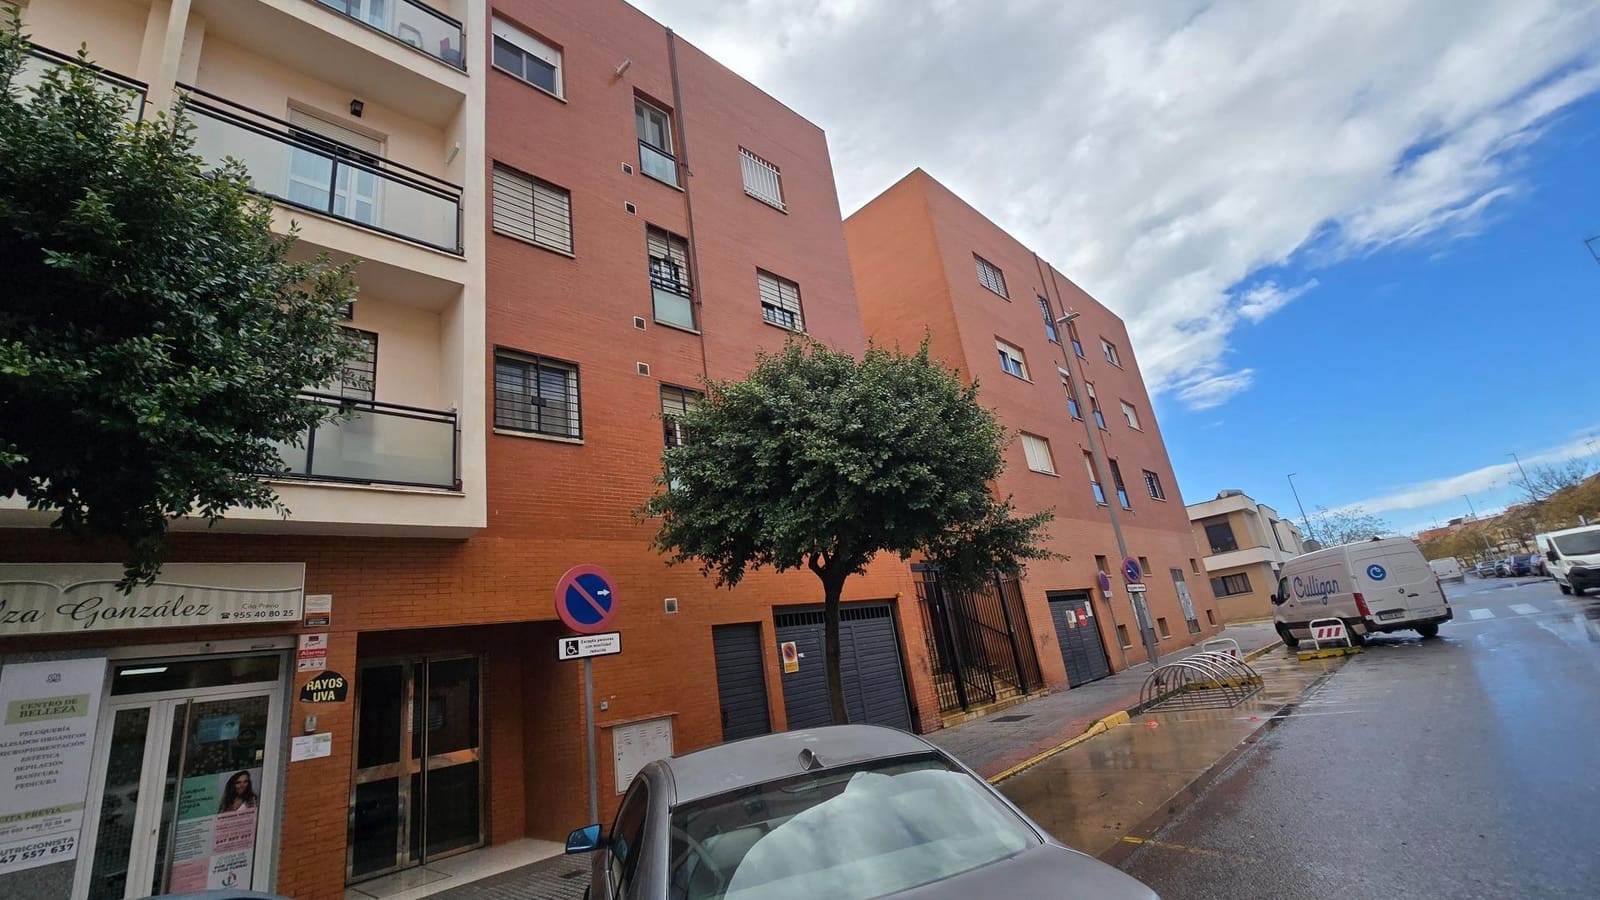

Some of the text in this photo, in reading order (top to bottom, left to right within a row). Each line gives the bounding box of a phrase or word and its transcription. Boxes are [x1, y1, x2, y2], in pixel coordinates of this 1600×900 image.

[1293, 575, 1340, 605] Culligan
[56, 595, 213, 628] González
[233, 611, 251, 619] 955
[283, 609, 294, 617] 25
[306, 677, 343, 692] RAYOS
[313, 690, 335, 702] UVA
[20, 697, 78, 710] CENTRO DE
[19, 704, 77, 718] BELLEZA
[25, 806, 62, 819] PREVIA
[22, 848, 46, 860] 557
[50, 842, 74, 854] 637
